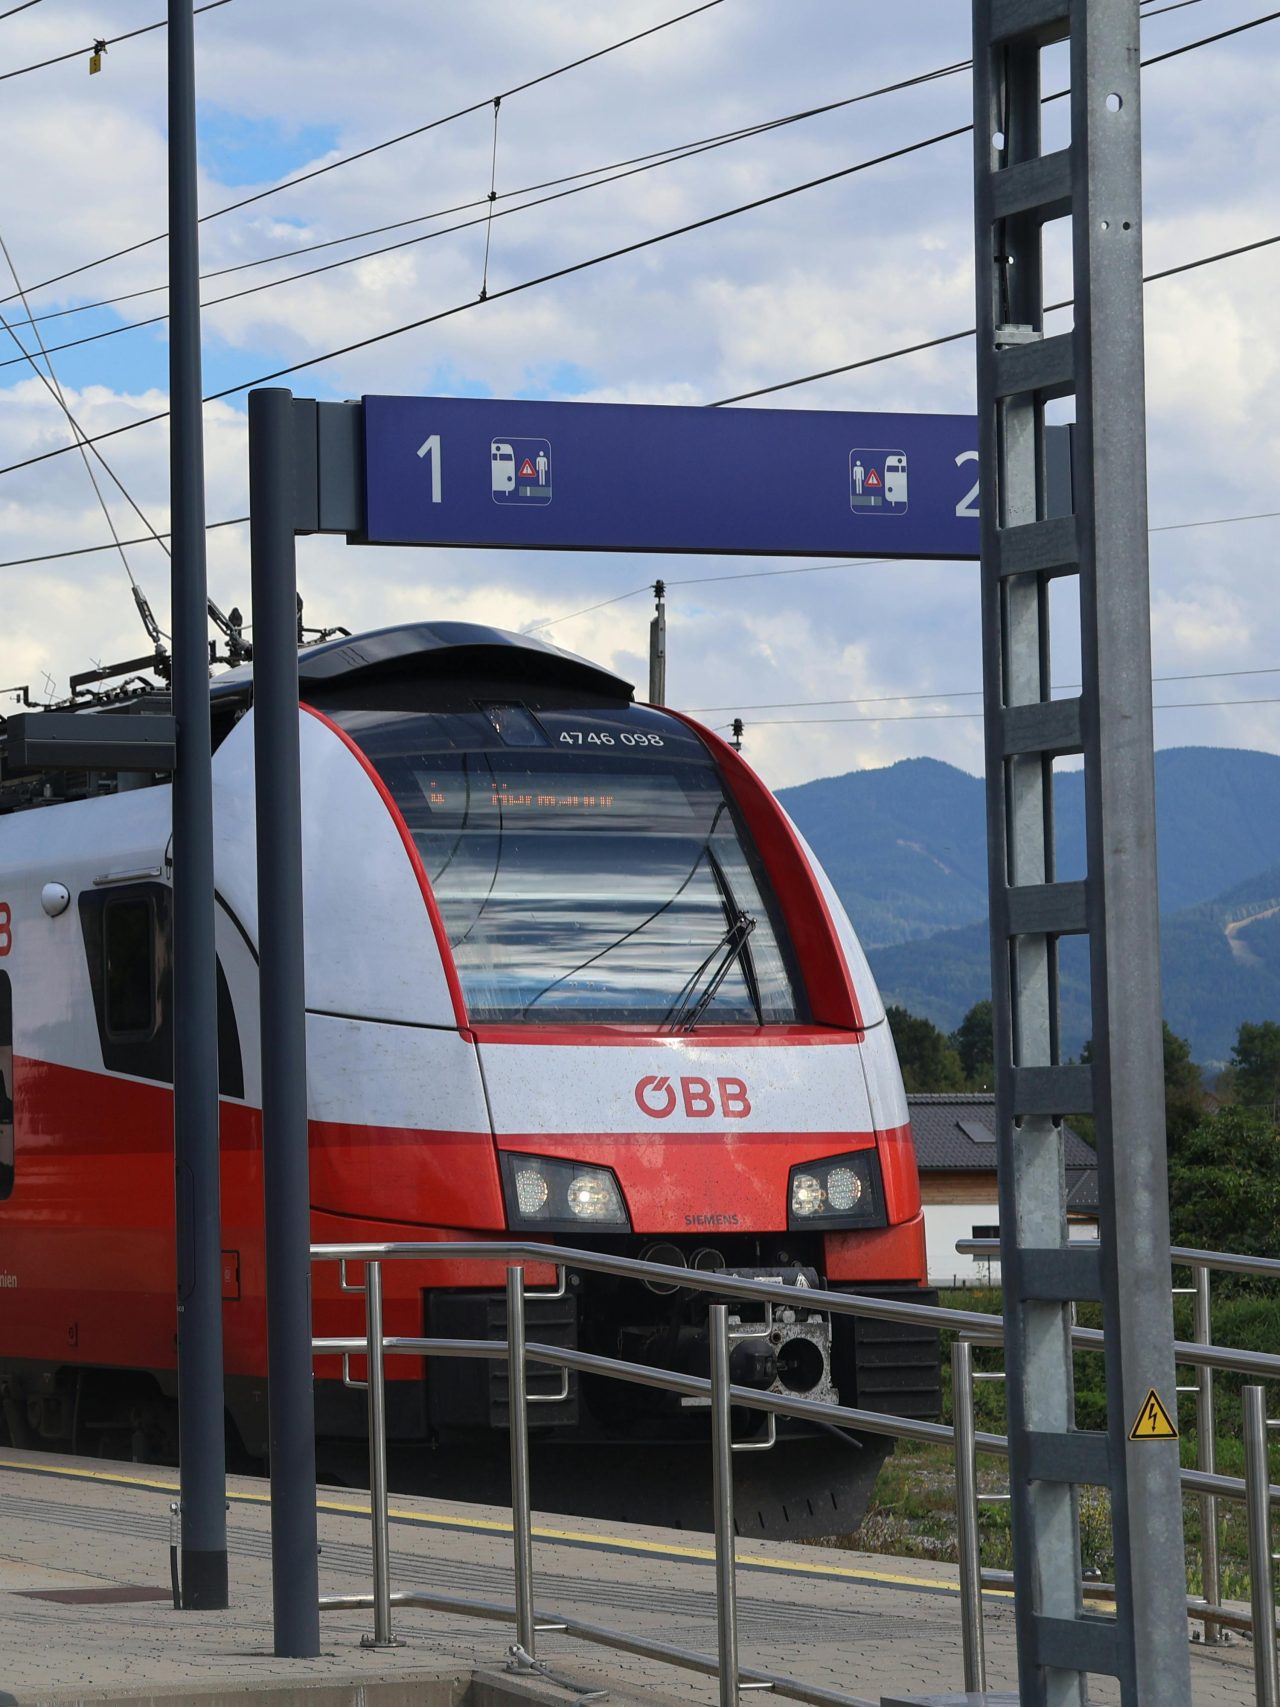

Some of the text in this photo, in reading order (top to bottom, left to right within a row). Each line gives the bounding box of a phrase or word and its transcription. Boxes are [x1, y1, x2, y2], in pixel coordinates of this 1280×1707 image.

[416, 435, 442, 503] 1
[954, 450, 981, 518] 2
[560, 731, 664, 746] 4746 098
[634, 1075, 752, 1119] ÖBB
[684, 1214, 740, 1226] SIEMENS
